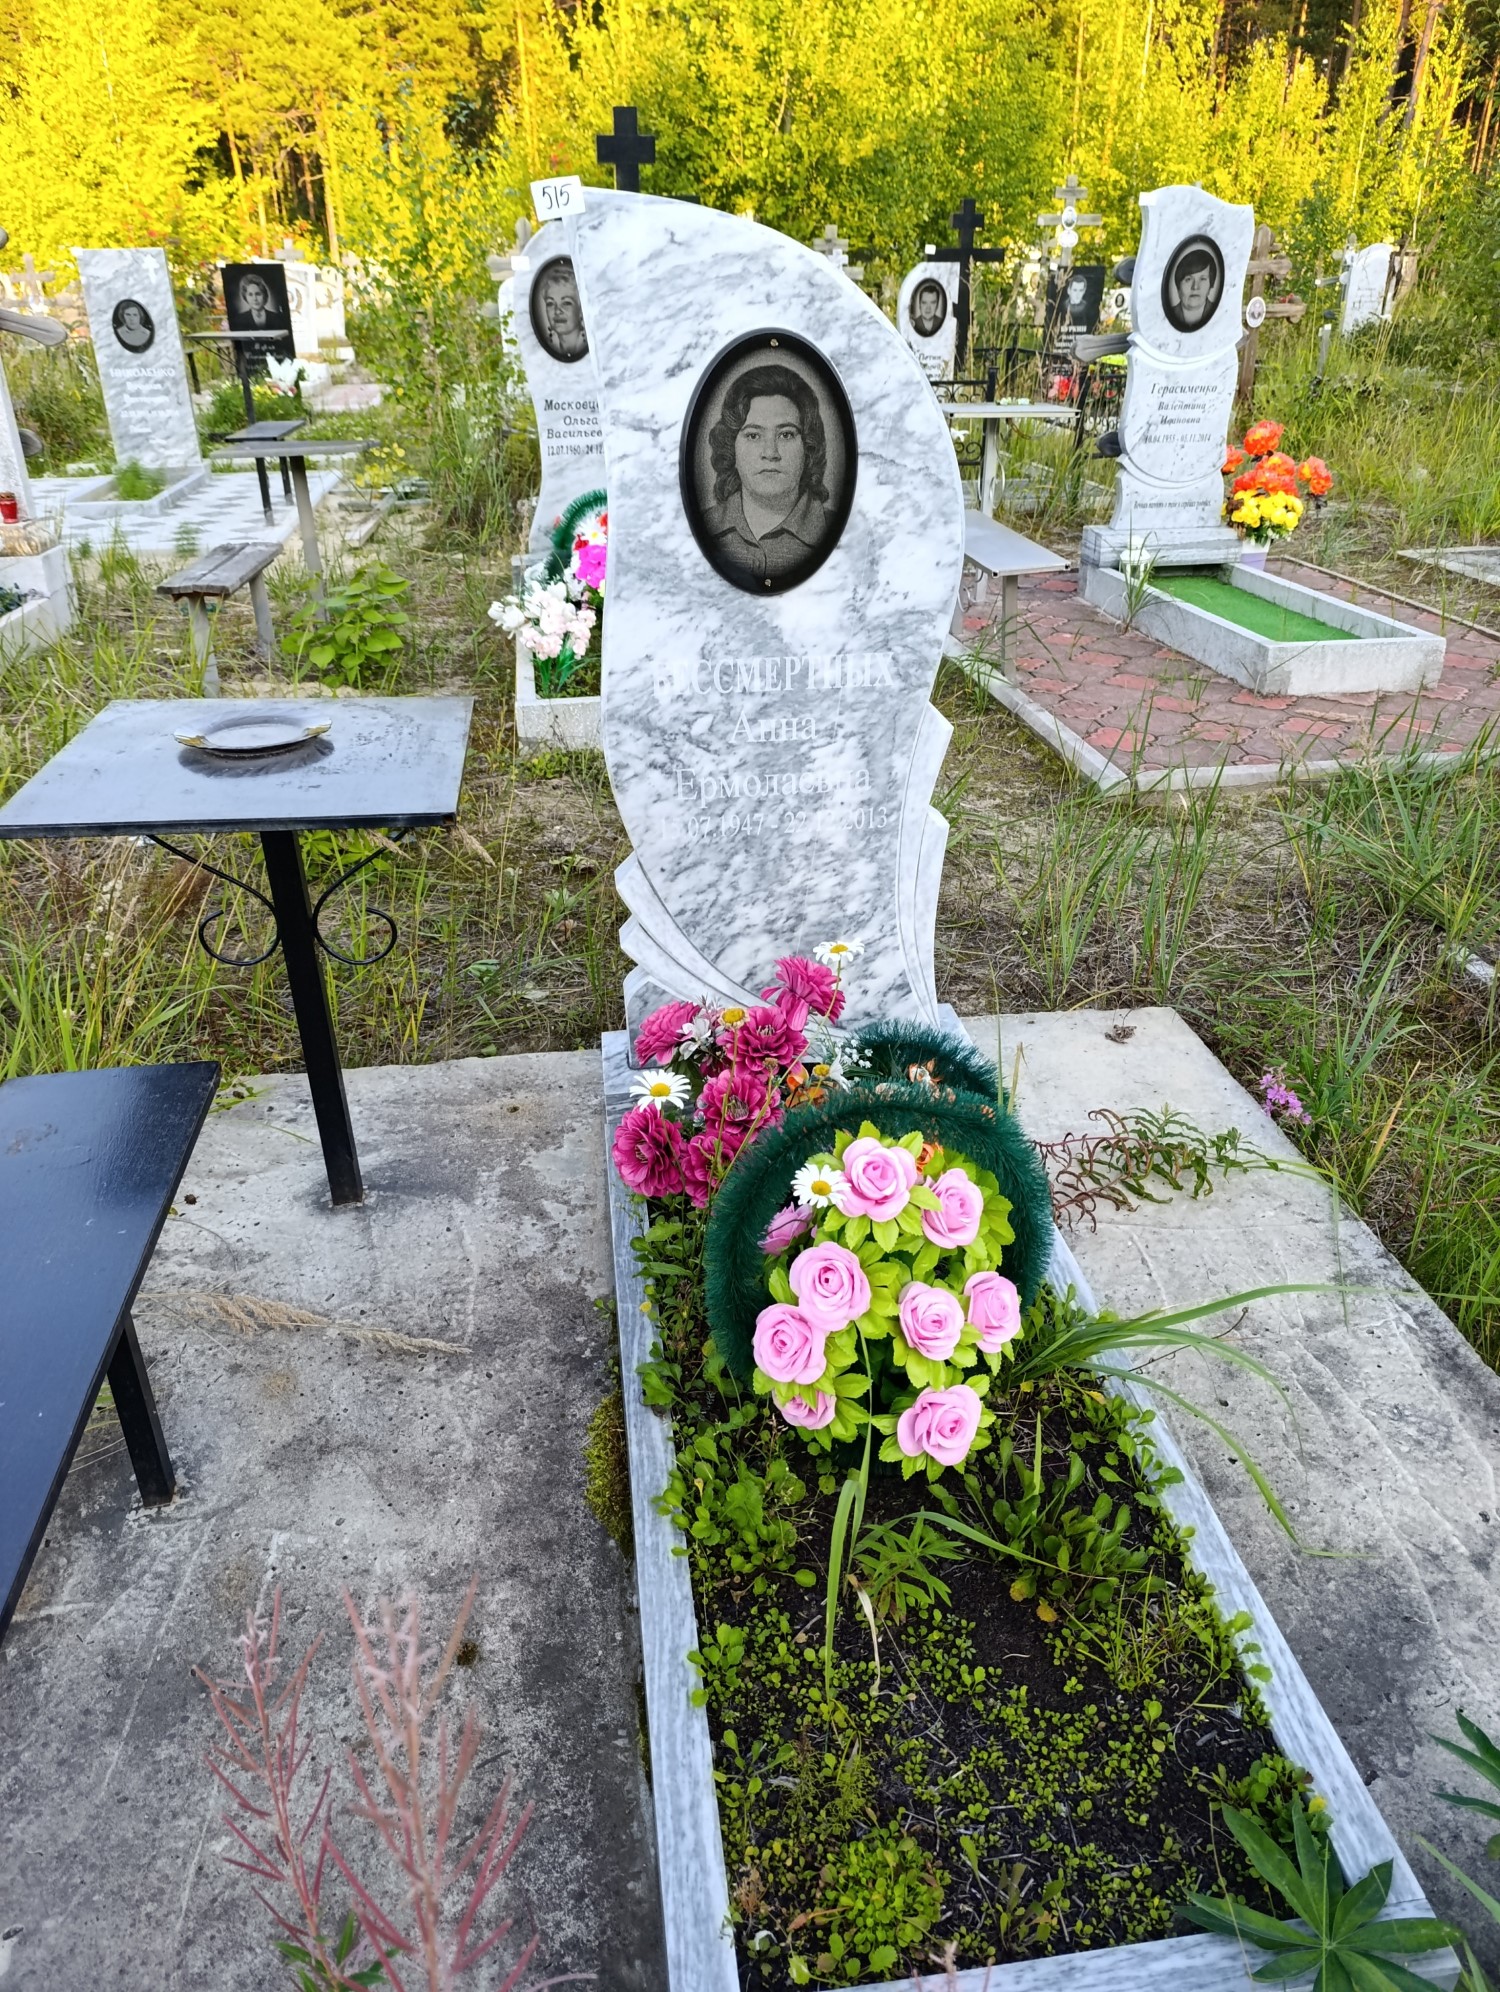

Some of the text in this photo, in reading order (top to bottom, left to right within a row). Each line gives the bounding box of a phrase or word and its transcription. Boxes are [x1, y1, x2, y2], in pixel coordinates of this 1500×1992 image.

[543, 183, 573, 210] 515
[1151, 382, 1217, 397] Герасименко
[547, 428, 603, 439] Васильев
[563, 415, 599, 426] Ольга
[653, 652, 896, 696] БЕССМЕРТНЫХ
[729, 709, 817, 744] Анна
[674, 769, 871, 809] Ермолаевна
